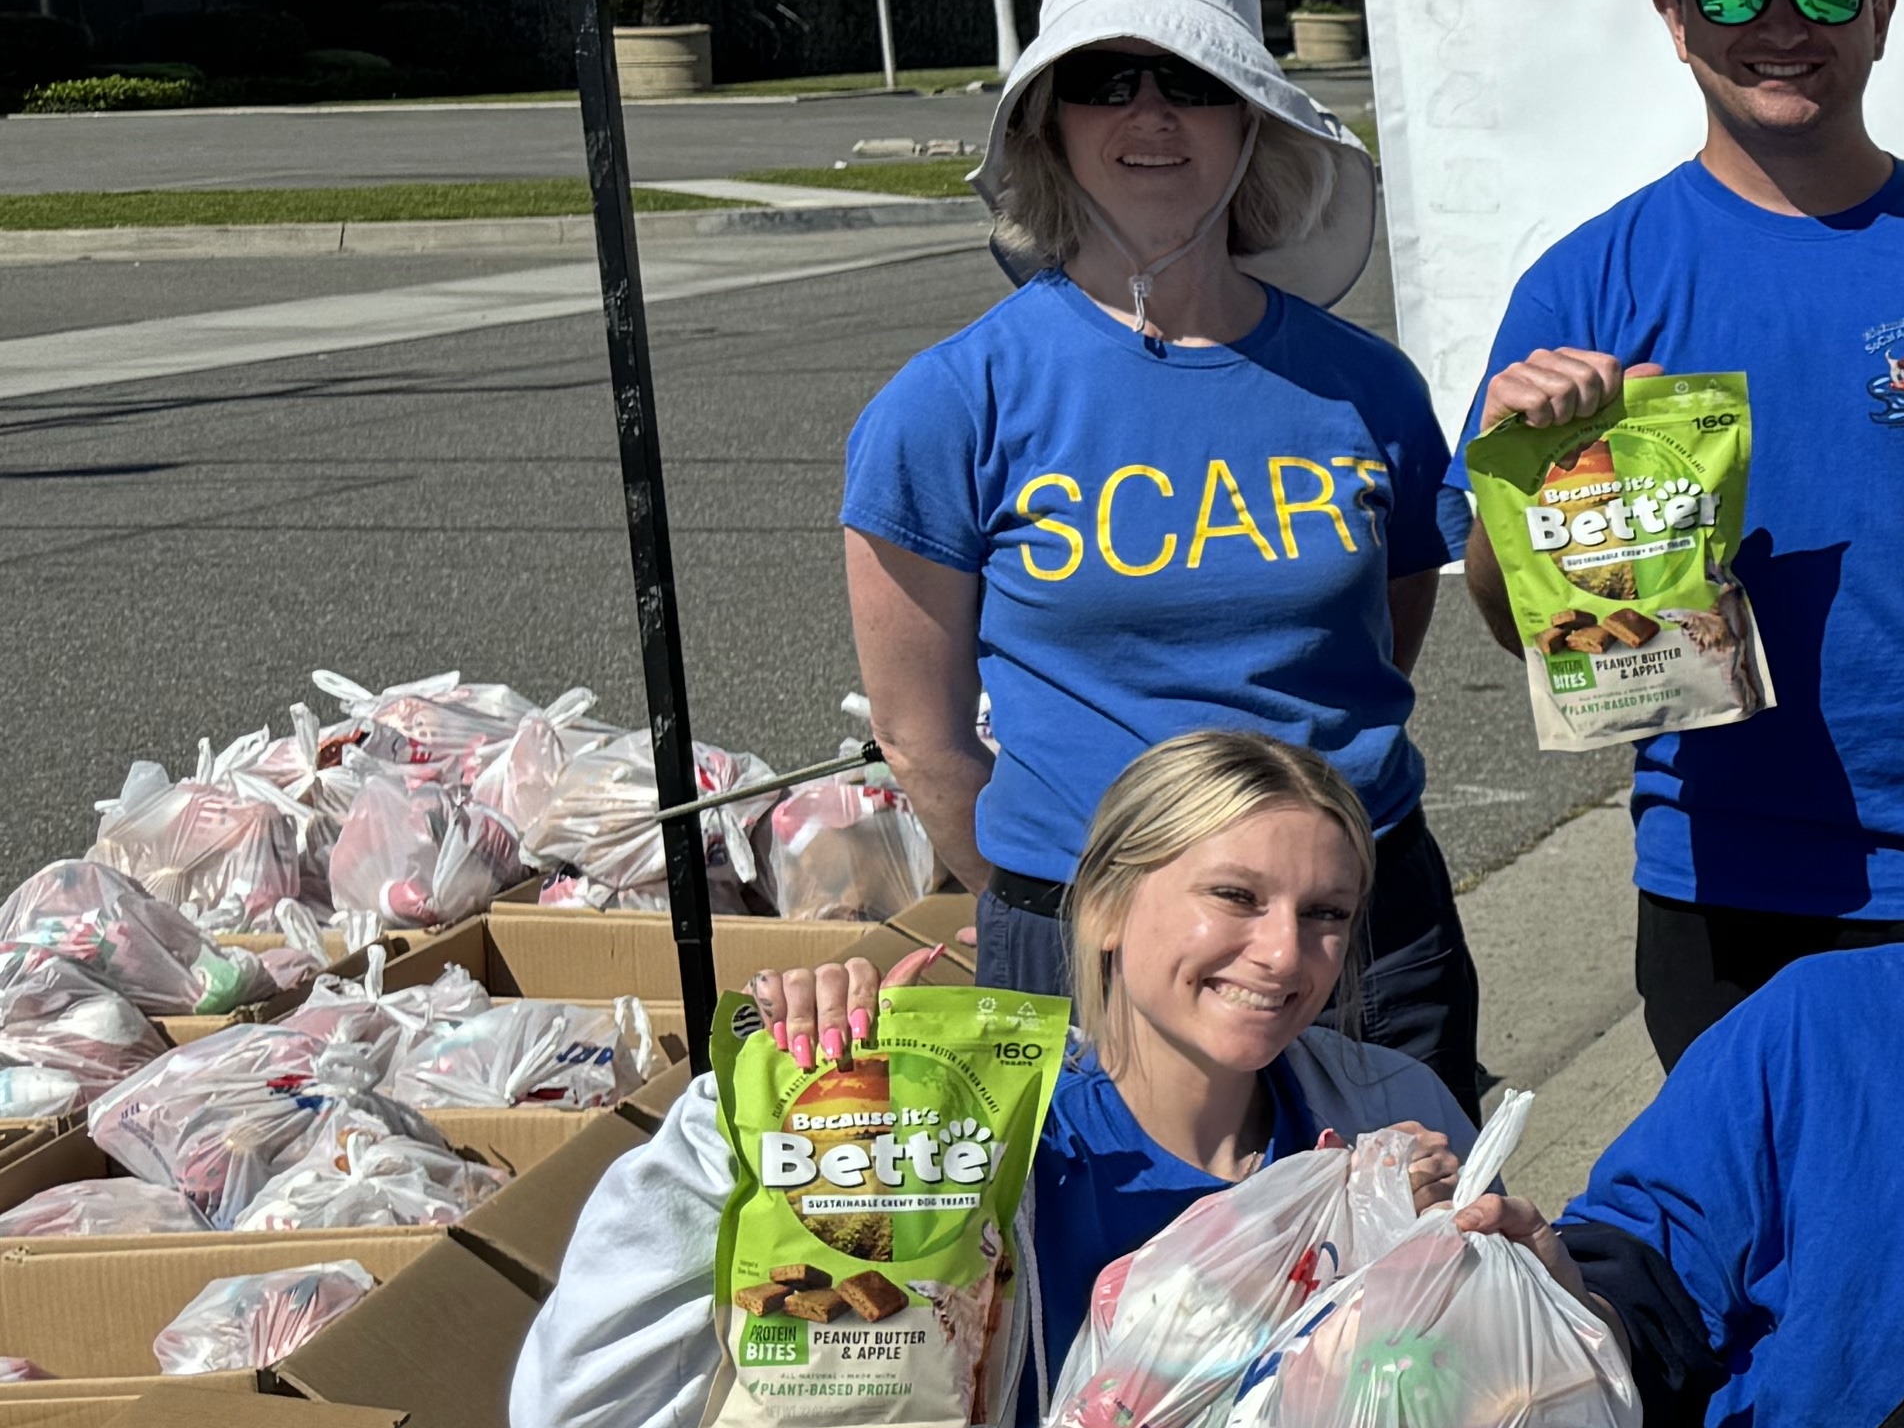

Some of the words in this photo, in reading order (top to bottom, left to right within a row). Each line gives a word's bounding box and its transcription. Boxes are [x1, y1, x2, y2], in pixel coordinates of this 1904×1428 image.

[1691, 413, 1735, 430] 160
[1544, 480, 1622, 505] Because
[1624, 475, 1656, 493] it's
[1016, 456, 1389, 581] SCART
[1525, 490, 1721, 552] Better
[1595, 654, 1638, 671] PEANUT
[1641, 647, 1682, 663] BUTTER
[1620, 669, 1629, 679] &
[1632, 662, 1665, 678] APPLE
[1553, 672, 1587, 690] BITES
[993, 1041, 1043, 1061] 160
[791, 1108, 898, 1131] Because
[901, 1107, 940, 1127] it's
[808, 1198, 879, 1209] SUSTAINABLE
[881, 1198, 913, 1208] CHEWY
[917, 1197, 937, 1207] DOG
[941, 1196, 977, 1206] TREATS
[749, 1324, 797, 1341] PROTEIN
[813, 1330, 870, 1345] PEANUT
[875, 1330, 926, 1345] BUTTER
[745, 1343, 797, 1361] BITES
[841, 1346, 852, 1360] &
[857, 1346, 902, 1360] APPLE
[760, 1383, 853, 1397] PLANT-BASED
[857, 1382, 912, 1396] PROTEIN
